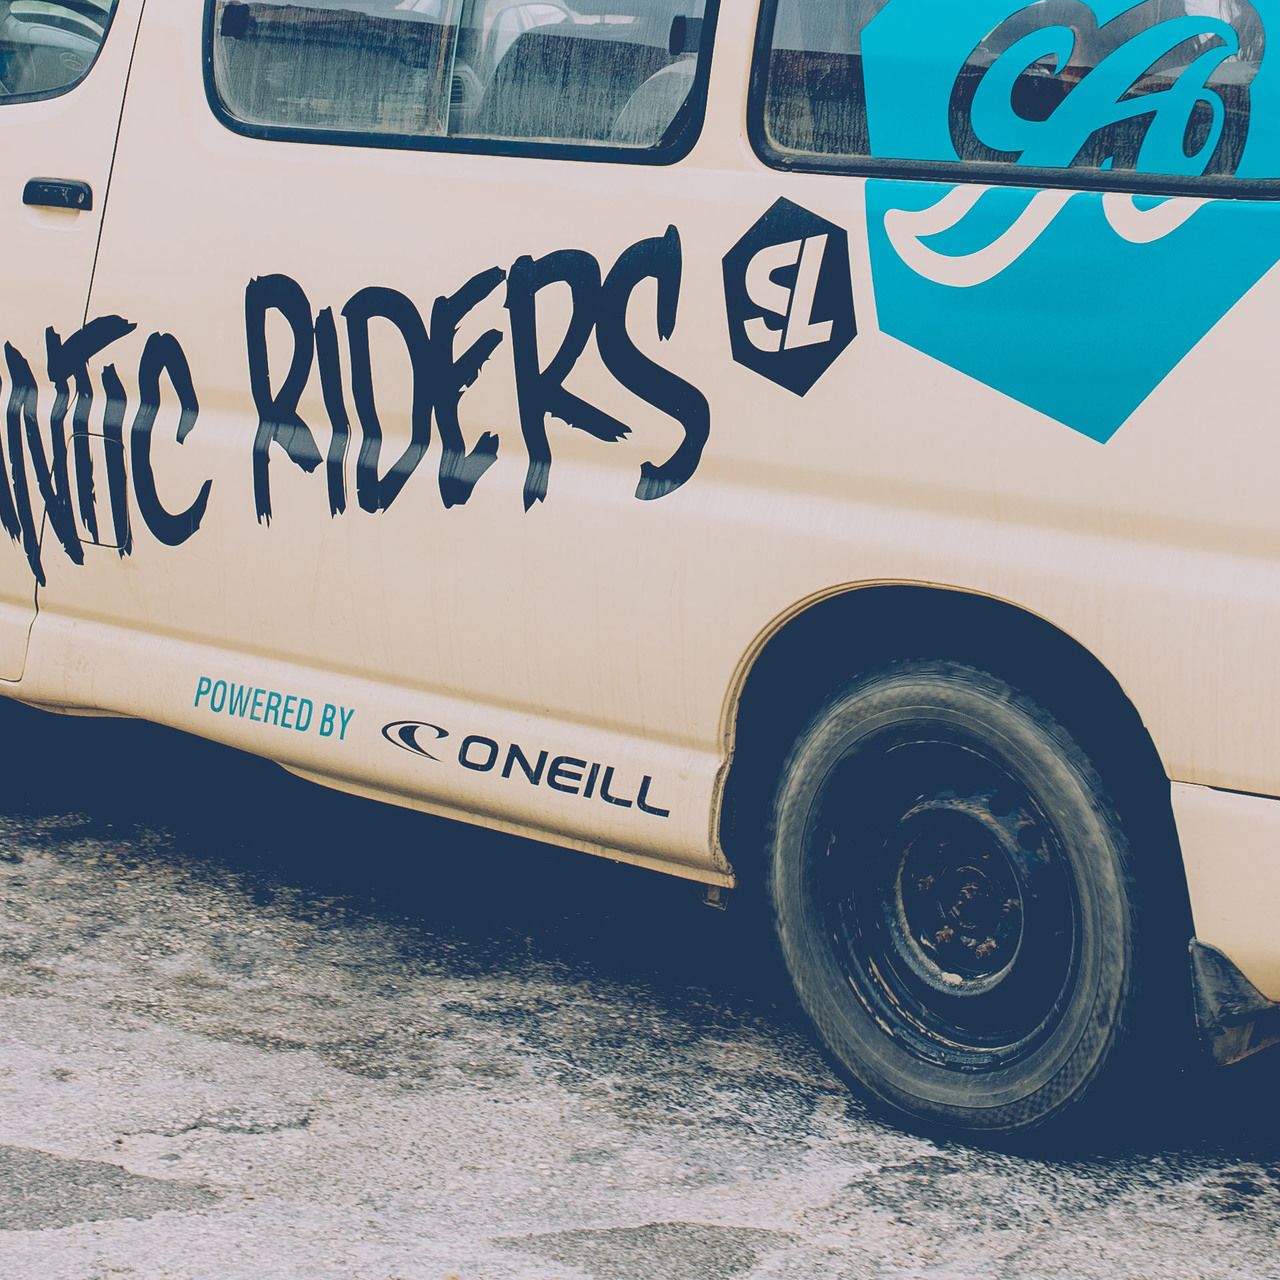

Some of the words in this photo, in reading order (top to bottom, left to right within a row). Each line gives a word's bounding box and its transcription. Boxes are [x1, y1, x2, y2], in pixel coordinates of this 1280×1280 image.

[245, 224, 710, 528] RIDERS
[194, 676, 314, 734] POWERED
[319, 703, 355, 741] BY
[458, 734, 671, 818] ONEILL
